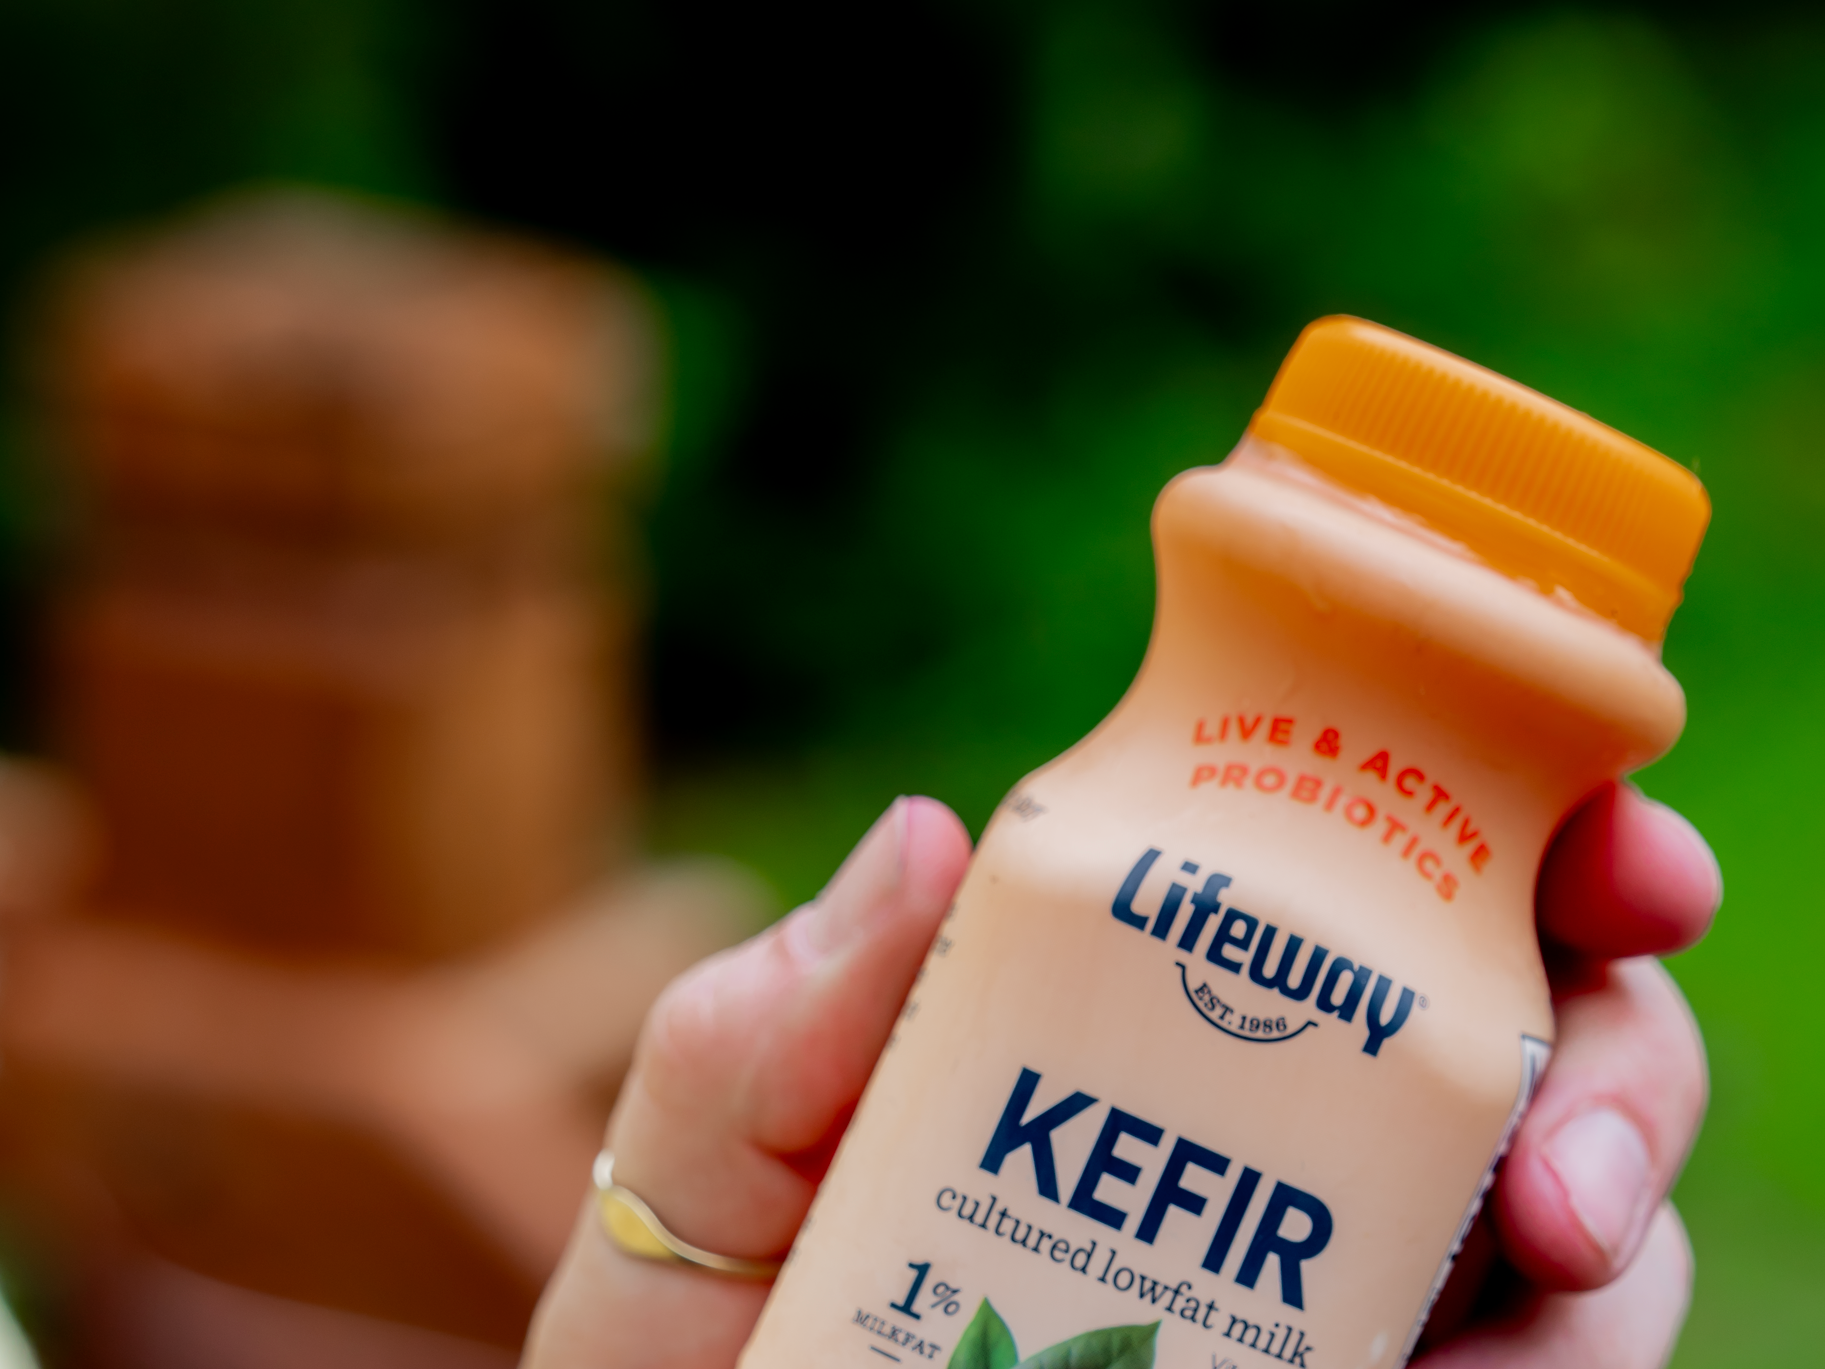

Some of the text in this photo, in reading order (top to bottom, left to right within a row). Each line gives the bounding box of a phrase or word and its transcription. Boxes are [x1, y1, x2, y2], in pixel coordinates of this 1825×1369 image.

[1190, 763, 1460, 903] PROBIOTICS
[1192, 714, 1493, 875] LIVE & ACTIVE
[1111, 847, 1416, 1057] Lifeway
[1192, 981, 1288, 1035] EST. 1986
[979, 1066, 1334, 1311] KEFIR
[851, 1308, 942, 1362] MILKFAT
[890, 1260, 961, 1321] 1%
[935, 1186, 1315, 1369] cultured lowfat milk
